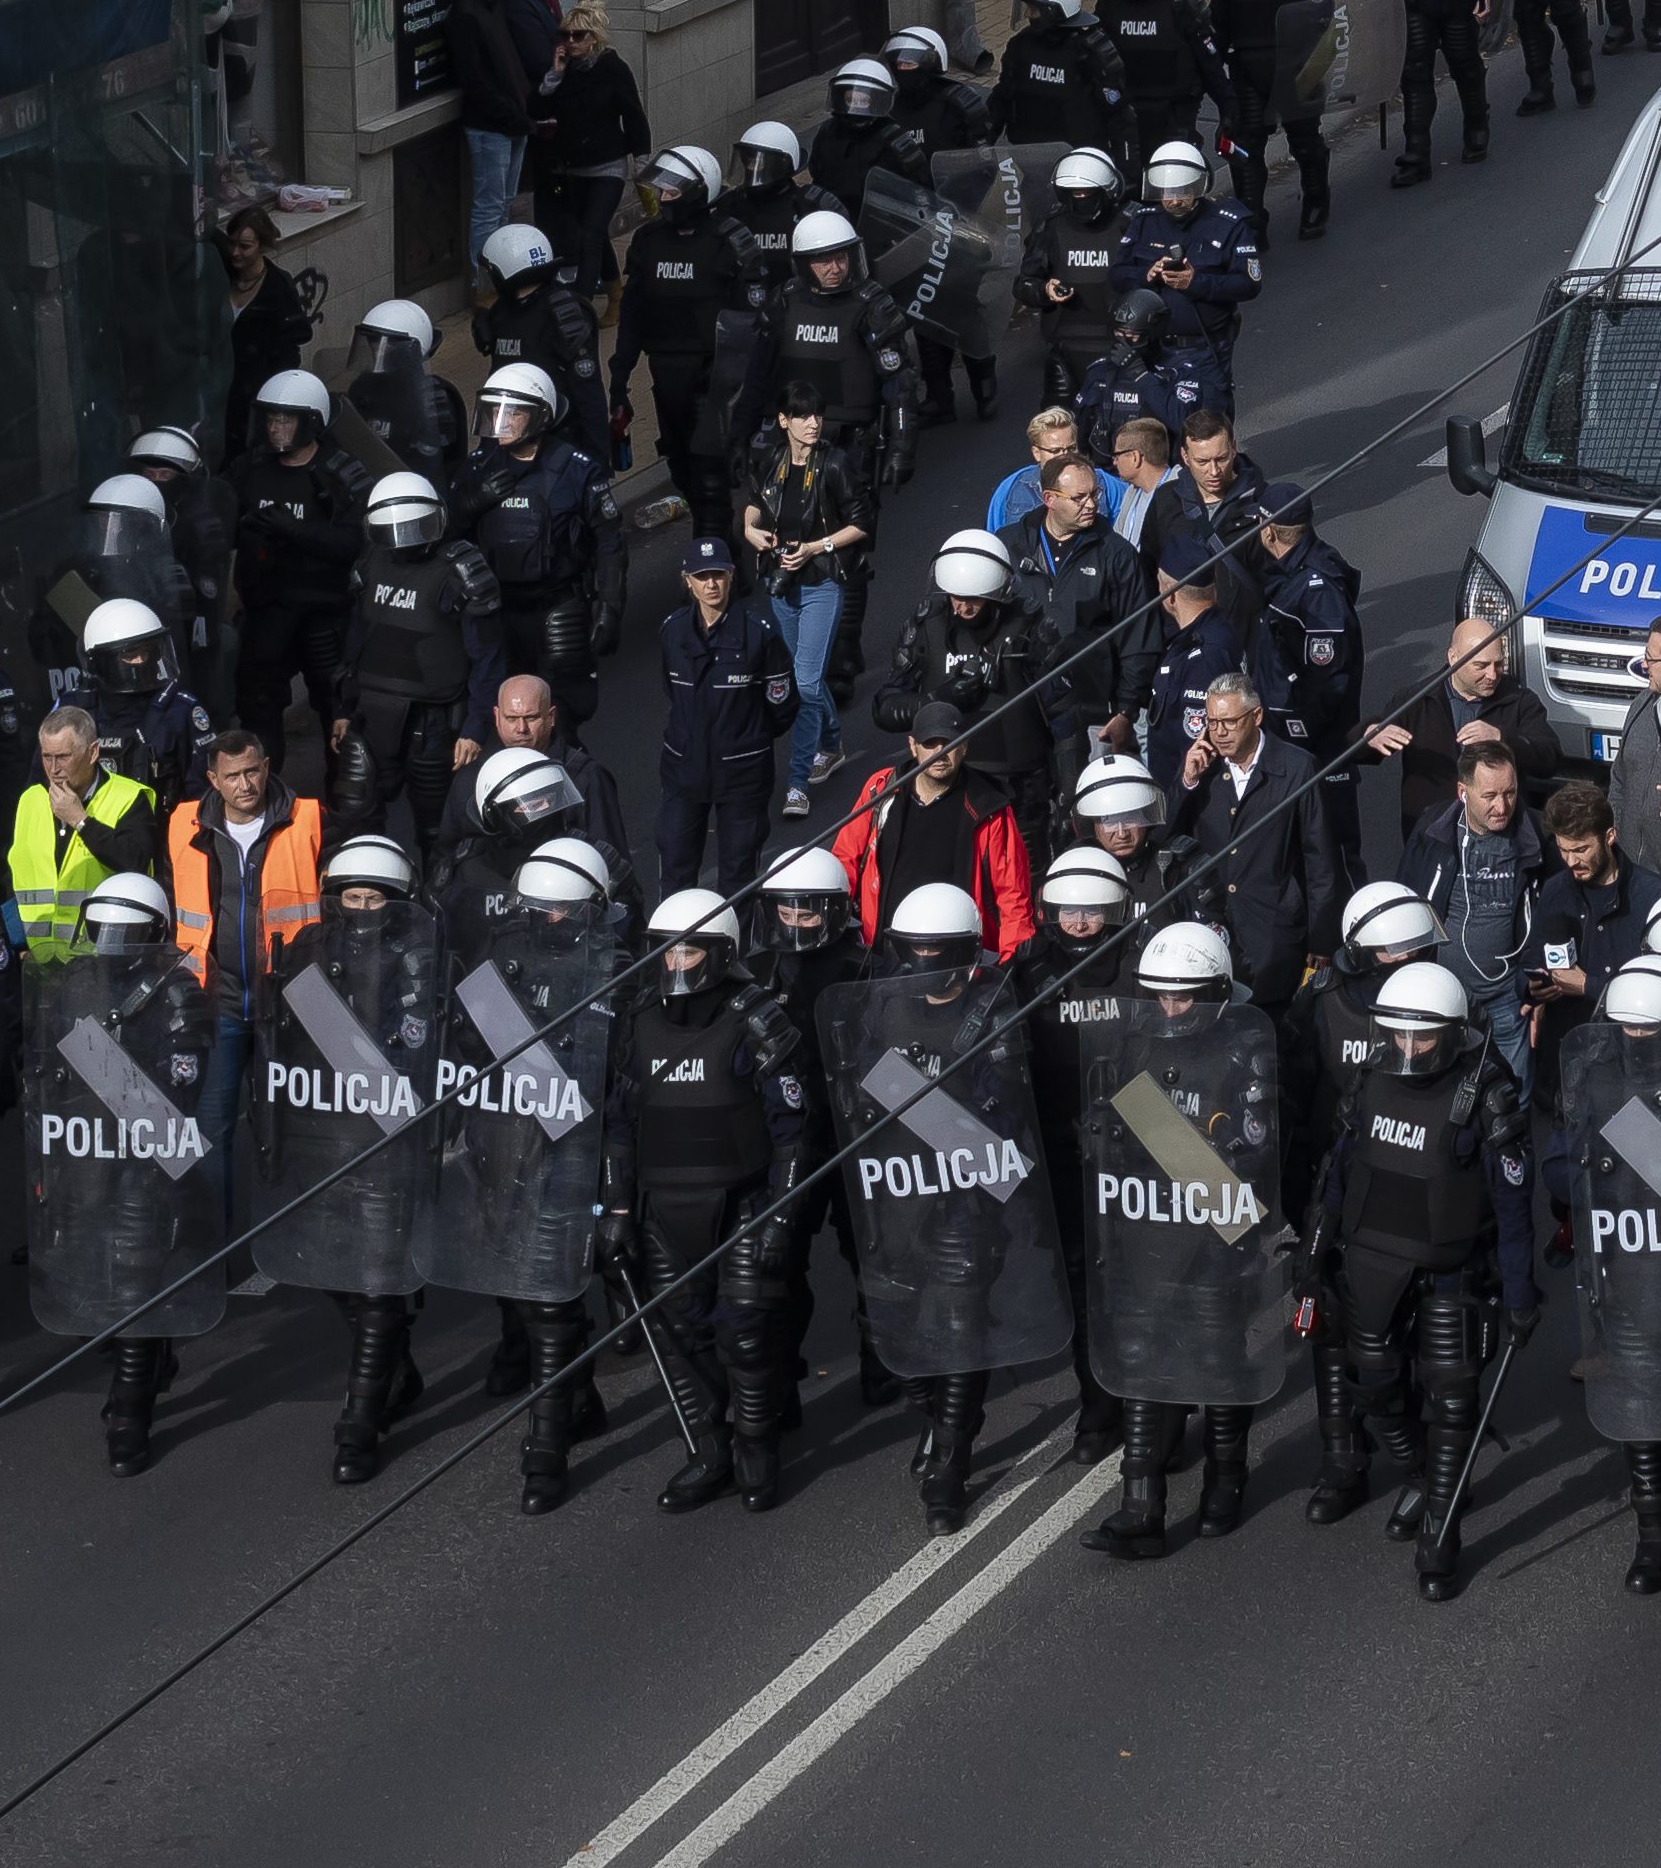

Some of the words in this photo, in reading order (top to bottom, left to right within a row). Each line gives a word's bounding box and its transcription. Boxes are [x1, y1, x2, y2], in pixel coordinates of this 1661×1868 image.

[1120, 19, 1157, 37] POLICJA
[1029, 63, 1066, 85] POLICJA
[529, 247, 546, 259] BL
[1068, 248, 1109, 269] POLICJA
[656, 261, 694, 281] POLICJA
[905, 209, 955, 322] POLICJA
[795, 324, 839, 345] POLICJA
[496, 337, 522, 357] POLICJA
[1113, 390, 1139, 404] POLICJA
[1059, 998, 1120, 1023] POLICJA
[267, 1062, 417, 1117] POLICJA
[436, 1060, 584, 1122] POLICJA
[41, 1114, 204, 1160] POLICJA
[1372, 1114, 1426, 1152] POLICJA
[859, 1140, 1028, 1200] POLICJA
[1099, 1173, 1260, 1226] POLICJA
